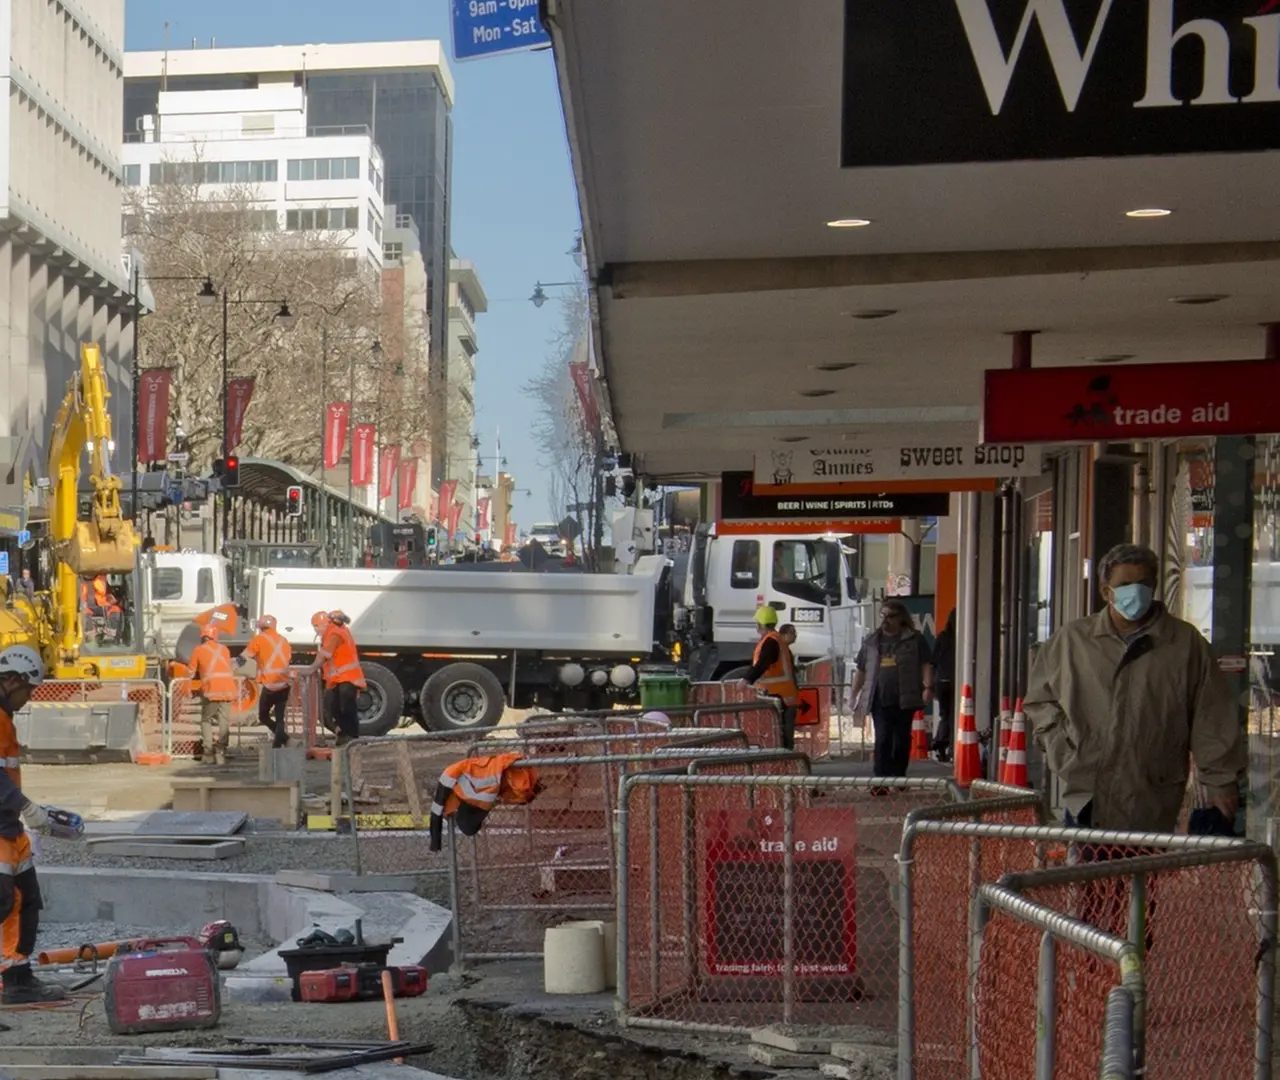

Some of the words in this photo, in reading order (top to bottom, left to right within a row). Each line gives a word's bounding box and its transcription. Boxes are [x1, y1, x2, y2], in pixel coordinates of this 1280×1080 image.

[469, 0, 497, 17] 9am
[473, 26, 501, 43] Mon
[512, 16, 537, 36] Sat
[1113, 404, 1181, 426] trade
[1191, 402, 1230, 422] aid
[813, 458, 874, 476] Annies
[777, 502, 800, 510] BEER
[806, 501, 829, 509] WINE
[835, 501, 866, 509] SPIRITS
[760, 838, 806, 853] trae
[812, 837, 838, 852] aid
